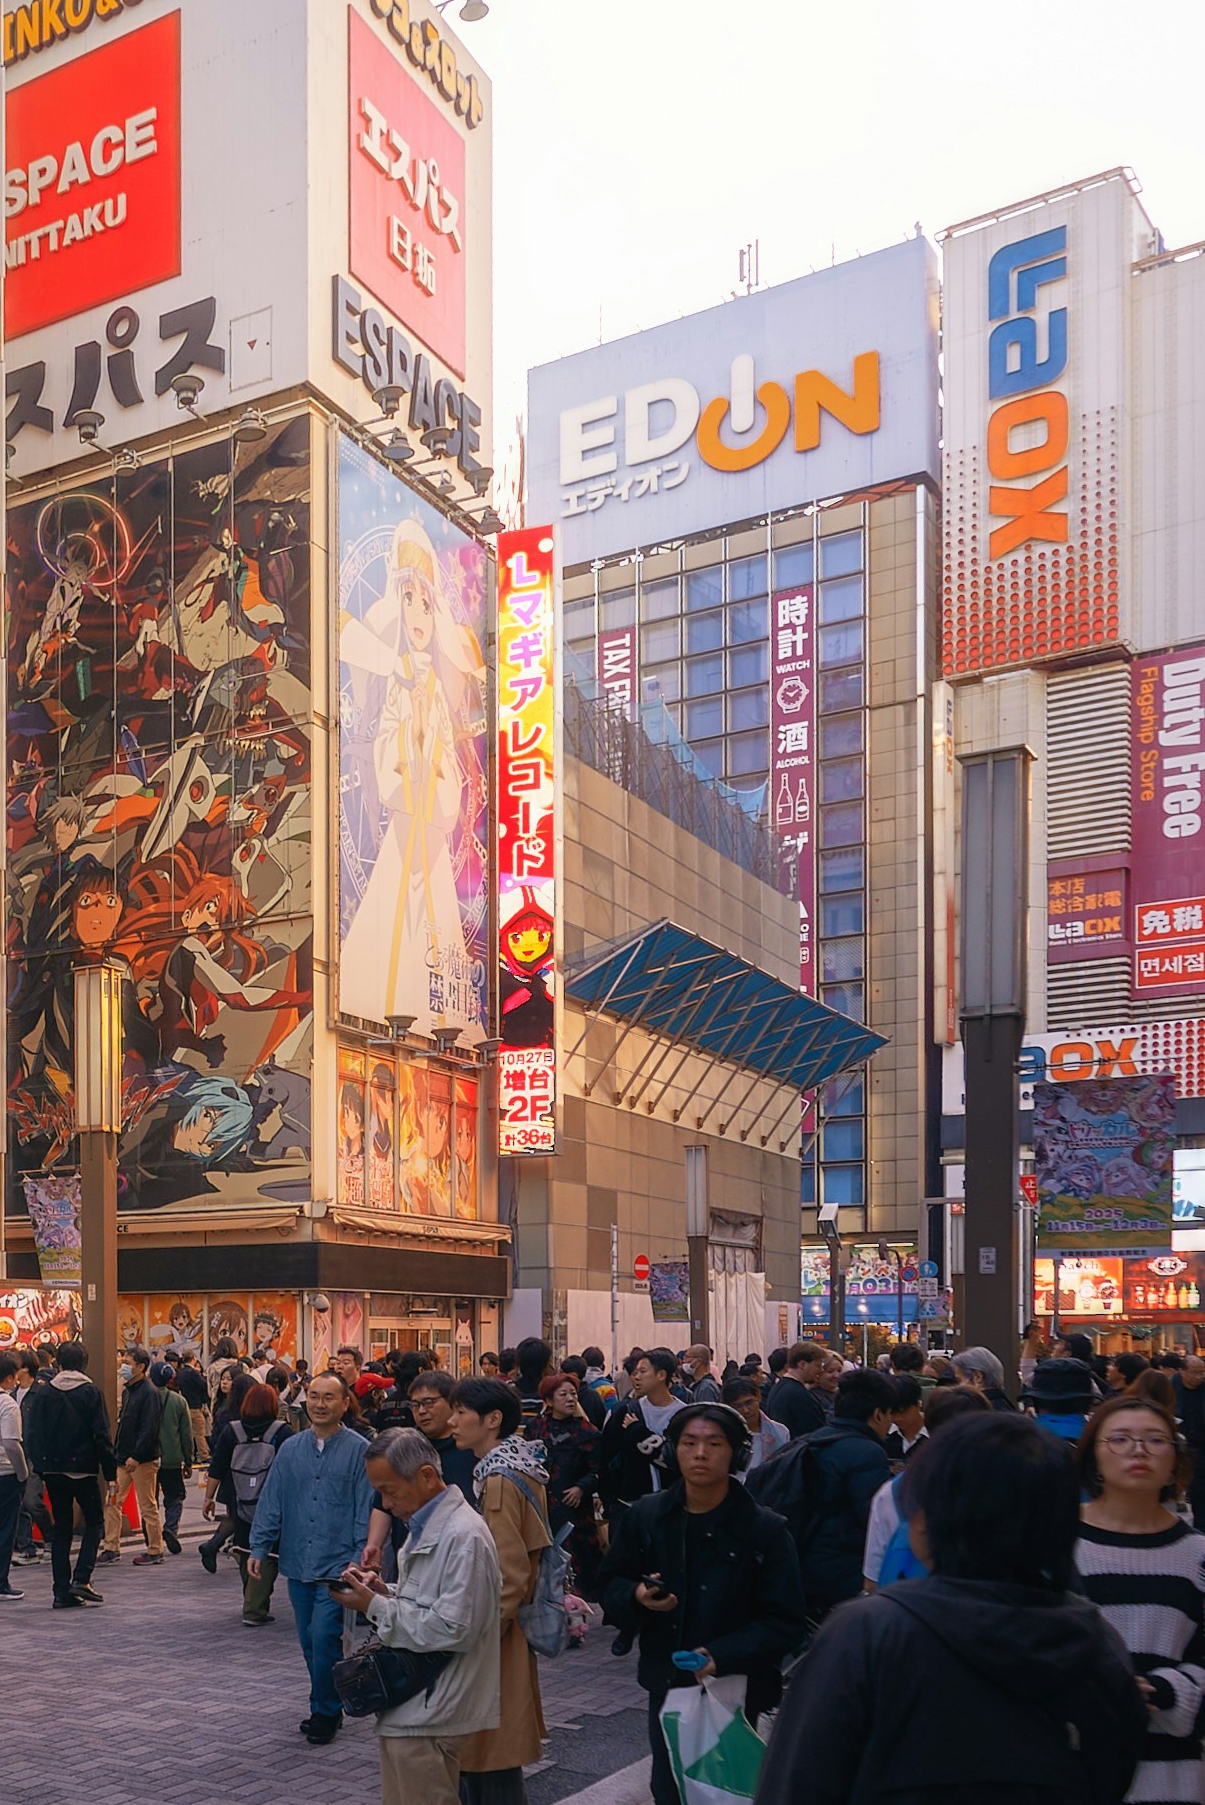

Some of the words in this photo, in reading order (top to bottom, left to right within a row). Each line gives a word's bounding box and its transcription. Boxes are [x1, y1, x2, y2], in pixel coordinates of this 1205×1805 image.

[358, 97, 463, 253] エスパス
[331, 274, 483, 476] ESPACE
[560, 461, 691, 520] エディオン
[777, 595, 809, 661] 時計
[603, 633, 631, 680] TAX
[775, 658, 811, 675] WATCH
[1135, 664, 1160, 746] Flagship
[1158, 657, 1205, 747] Duty
[777, 720, 809, 755] 酒
[775, 755, 811, 771] ALCOHOL
[1139, 749, 1160, 804] Store
[1162, 751, 1205, 840] Free
[1048, 877, 1086, 898] 本店
[1048, 890, 1123, 917] 総合家電
[1140, 904, 1205, 937] 免税
[1139, 952, 1205, 981] 면세점
[499, 1050, 554, 1067] 10月27日
[503, 1069, 551, 1092] 増台
[507, 1094, 550, 1123] 2F
